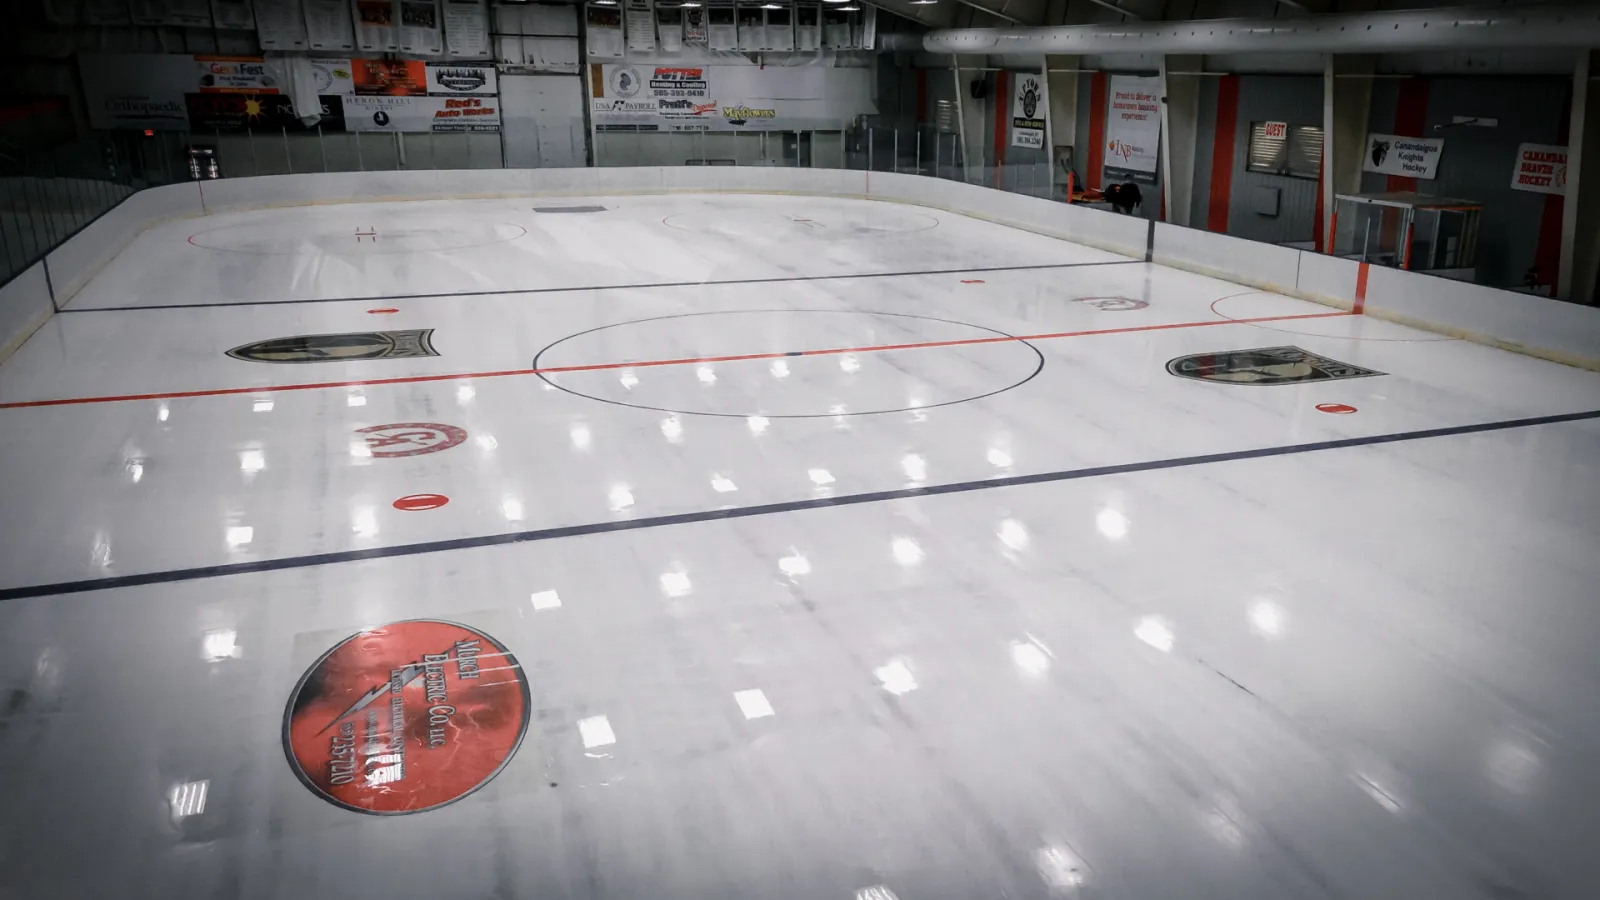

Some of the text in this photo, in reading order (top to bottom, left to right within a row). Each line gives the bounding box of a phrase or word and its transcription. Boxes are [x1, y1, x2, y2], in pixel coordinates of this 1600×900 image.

[625, 102, 657, 110] PAYROLL
[1264, 123, 1286, 137] GUEST
[1394, 141, 1438, 154] Canandaigua
[1397, 151, 1424, 163] Knights
[1402, 163, 1427, 174] Hockey
[1518, 174, 1553, 187] HOCKEY
[455, 639, 482, 680] MURCH
[424, 653, 450, 705] ELECTRIC
[427, 704, 457, 728] CO.
